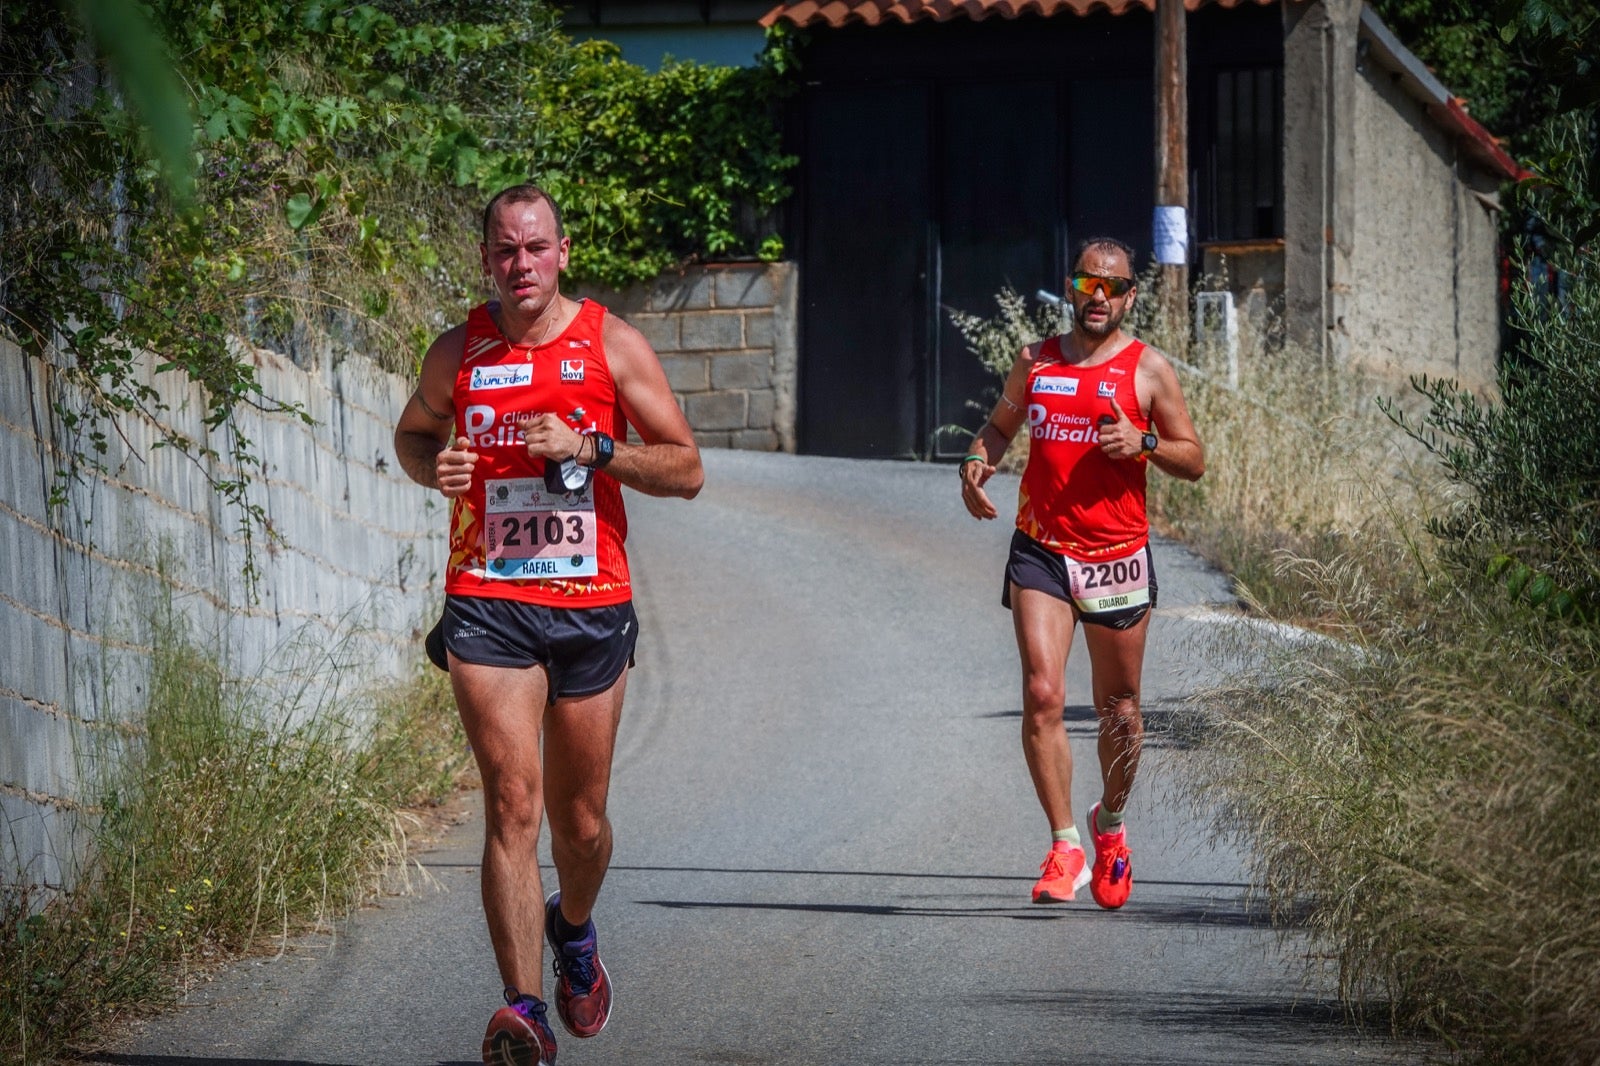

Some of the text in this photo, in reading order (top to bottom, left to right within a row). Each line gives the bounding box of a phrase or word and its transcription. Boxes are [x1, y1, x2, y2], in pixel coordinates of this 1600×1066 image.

[563, 361, 568, 372] I
[1051, 413, 1091, 425] Clínicas
[501, 515, 585, 546] 2103
[522, 561, 558, 575] RAFAEL
[1081, 558, 1141, 590] 2200
[1098, 595, 1129, 609] EDUARDO
